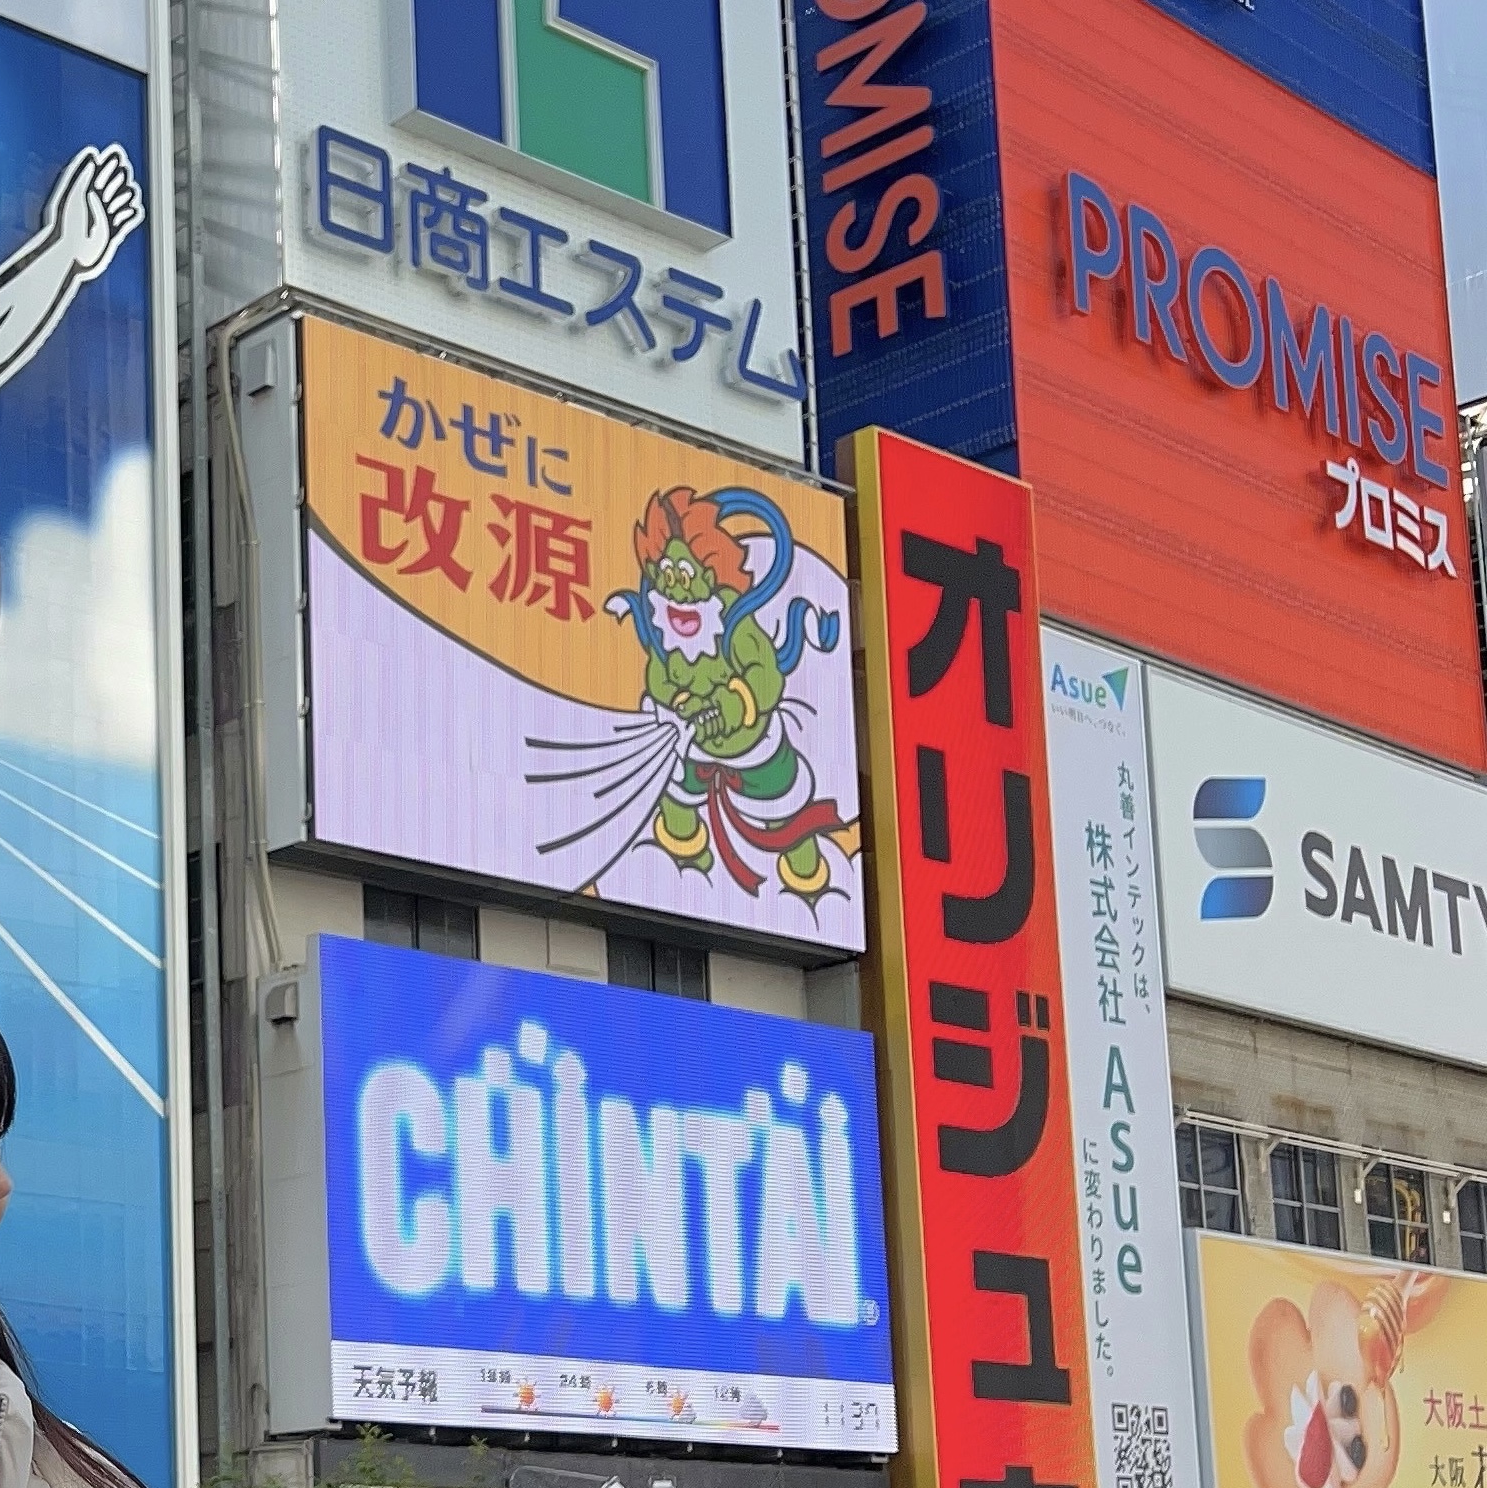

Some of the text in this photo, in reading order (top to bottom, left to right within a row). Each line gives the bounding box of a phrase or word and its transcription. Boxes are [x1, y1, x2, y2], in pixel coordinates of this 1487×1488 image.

[318, 125, 807, 400] 日商エステム
[816, 0, 946, 358] MISE
[1067, 170, 1448, 488] PROMISE
[355, 453, 597, 624] 改源
[378, 376, 573, 496] かぜに
[1326, 457, 1457, 578] プロミス
[1051, 664, 1106, 709] Asue
[1085, 819, 1143, 1296] 株式会社 Asue
[1083, 1137, 1114, 1378] に変わりました。
[353, 1364, 438, 1404] 天気予報
